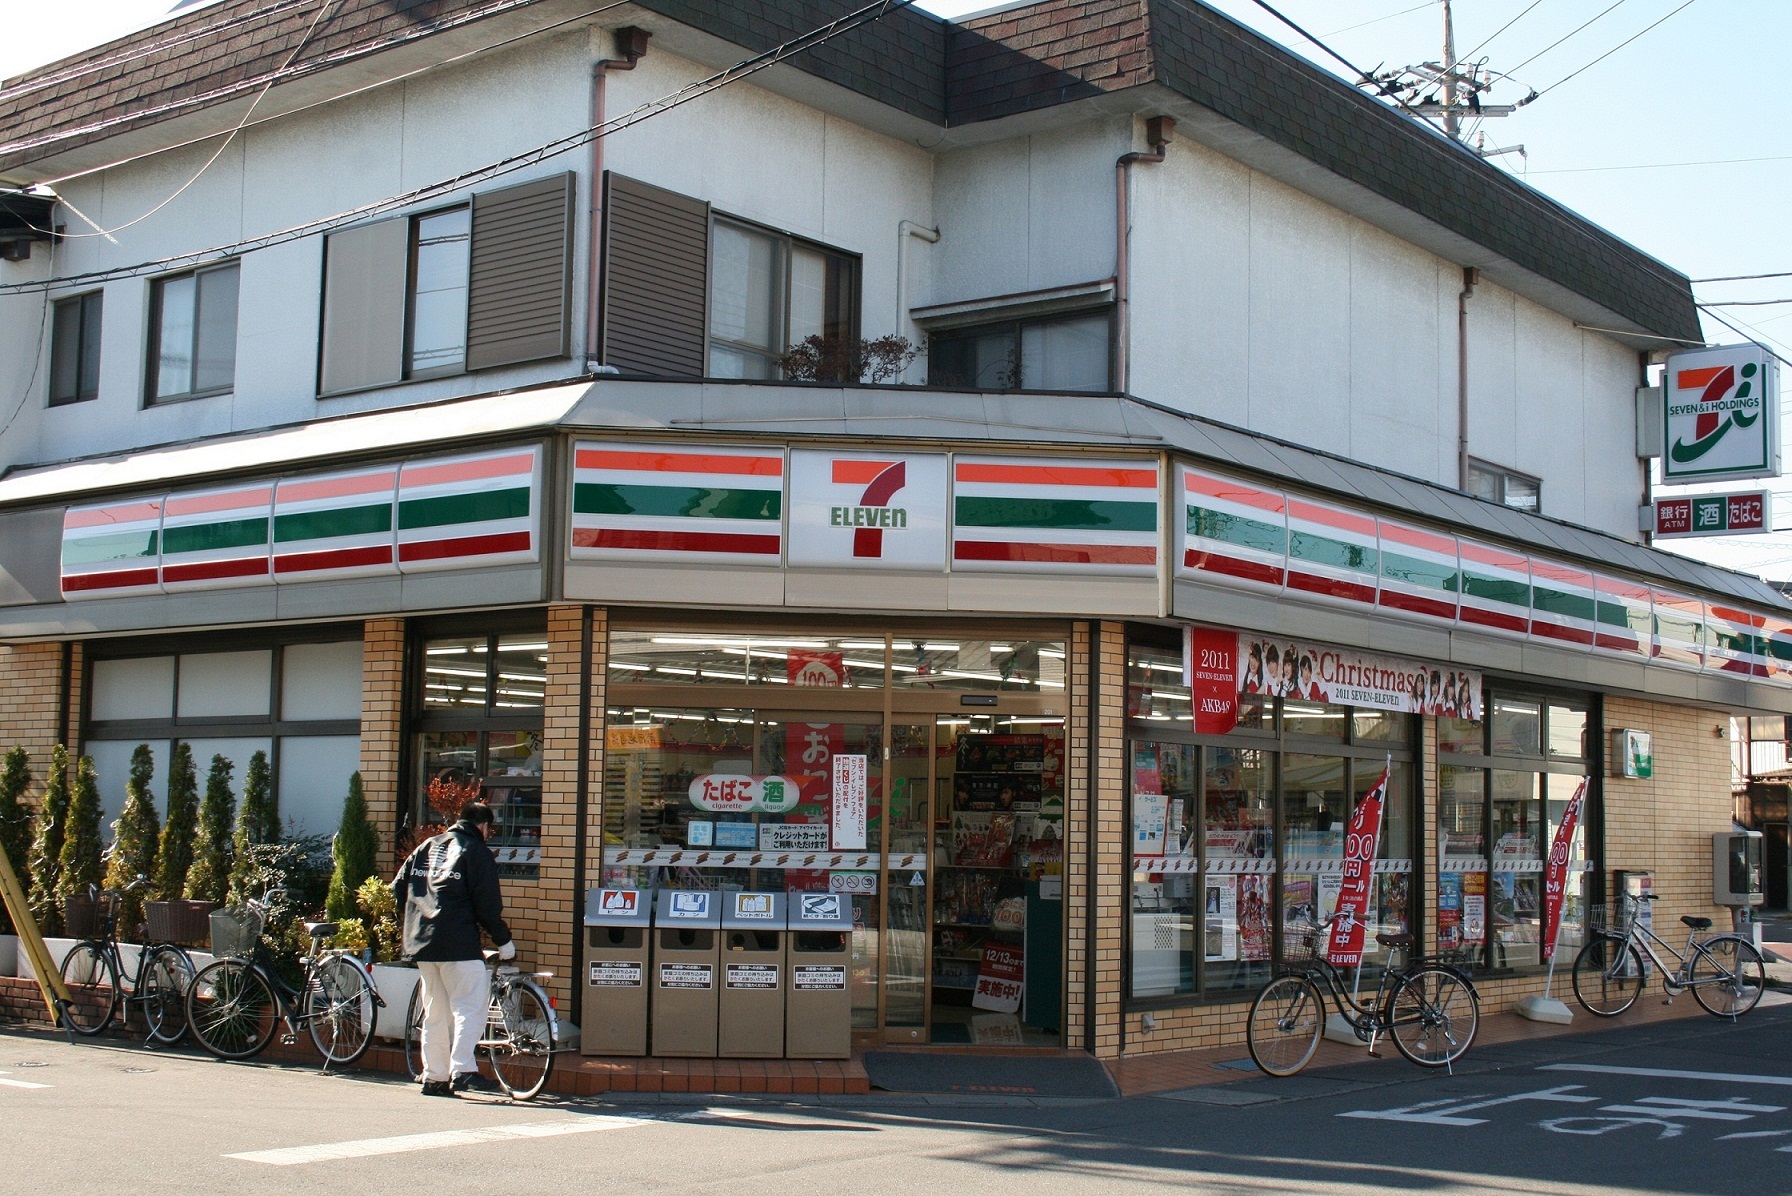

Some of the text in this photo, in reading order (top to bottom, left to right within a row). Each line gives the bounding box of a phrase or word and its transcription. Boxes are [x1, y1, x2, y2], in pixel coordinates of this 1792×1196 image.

[1711, 396, 1760, 412] HOLDINGS
[831, 459, 906, 558] 7
[1660, 505, 1689, 520] 銀行
[1698, 503, 1720, 527] 酒
[1728, 501, 1762, 524] たばこ
[1664, 520, 1686, 529] ATM
[1201, 648, 1230, 670] 2011
[1319, 651, 1415, 693] Christmas
[1335, 687, 1350, 700] 2011
[1200, 697, 1231, 714] AKB48
[702, 779, 753, 802] たばこ
[762, 781, 785, 803] 酒
[773, 831, 828, 840] クレジットカードが
